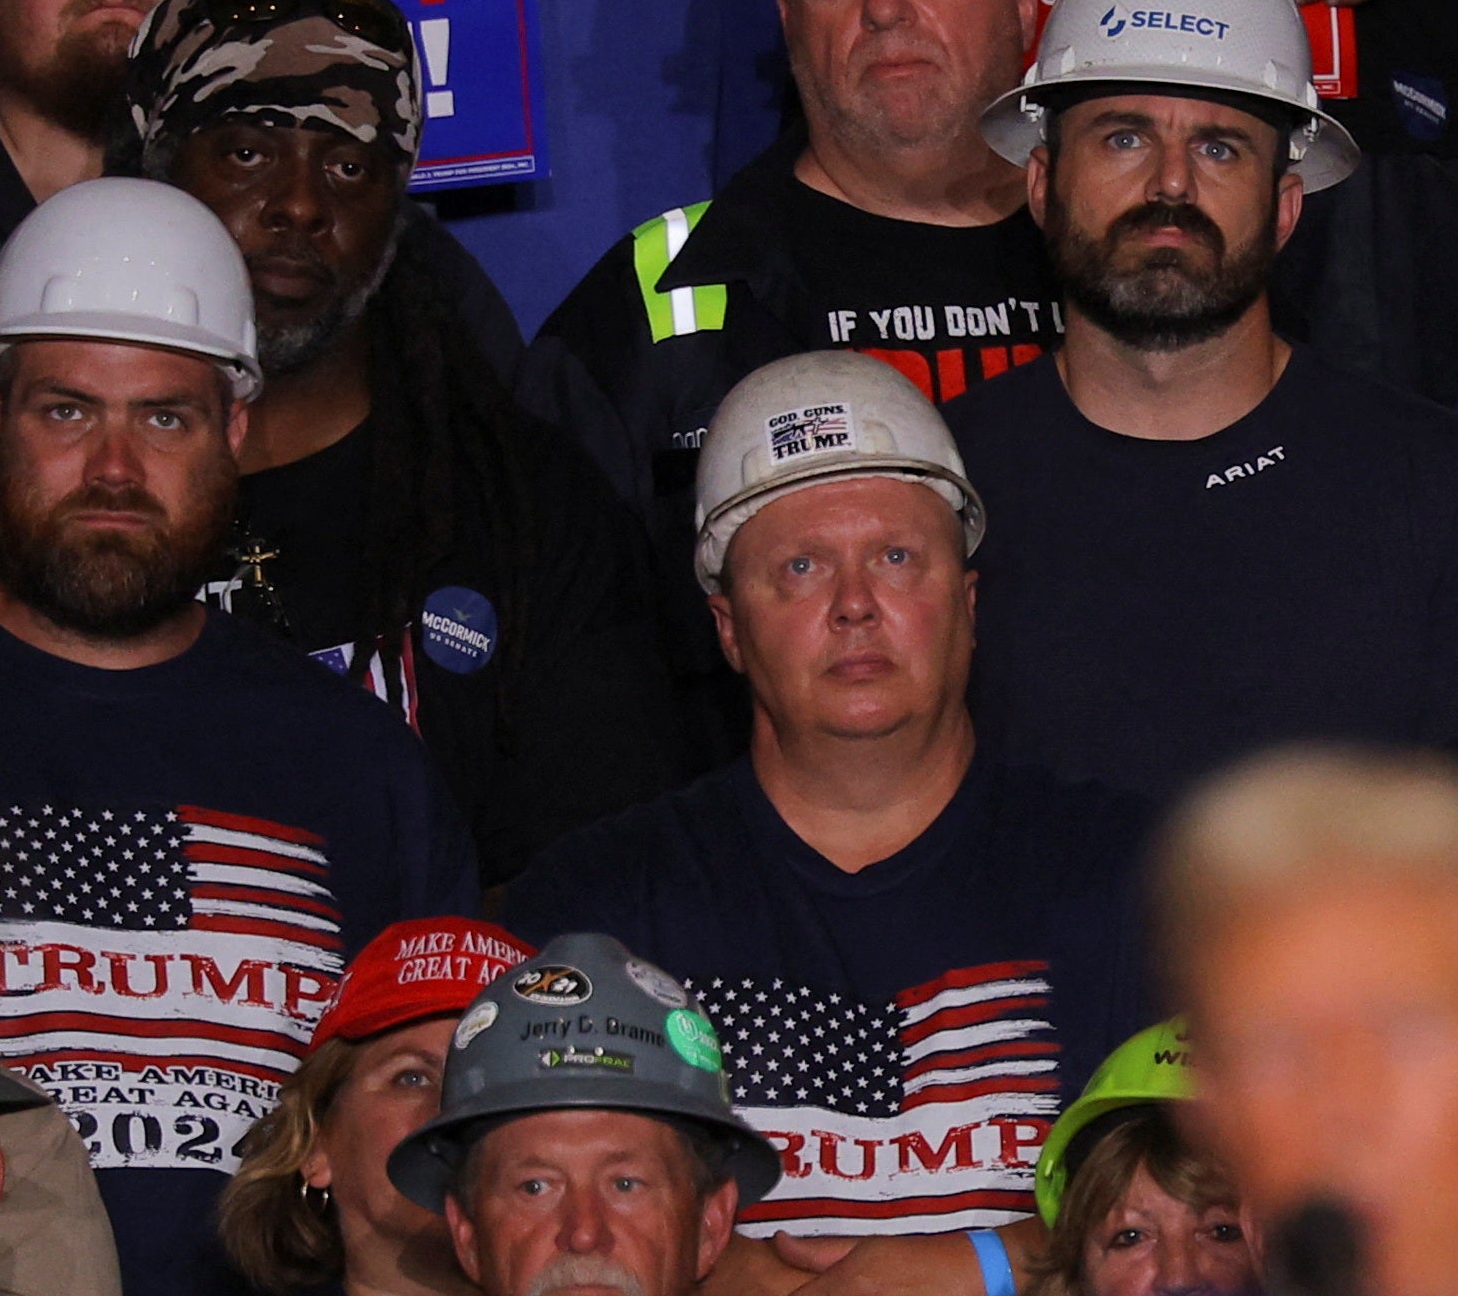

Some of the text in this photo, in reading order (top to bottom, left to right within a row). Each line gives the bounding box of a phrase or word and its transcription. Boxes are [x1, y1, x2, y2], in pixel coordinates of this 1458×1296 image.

[1131, 10, 1230, 40] SELECT
[828, 310, 858, 343] IF
[869, 305, 936, 341] YOU
[944, 297, 1041, 337] DON'T
[1205, 445, 1286, 490] ARIAT
[444, 638, 478, 658] SENATE
[394, 932, 453, 961] MAKE
[397, 957, 471, 985] GREAT
[519, 1016, 572, 1042] Jerry
[563, 1053, 630, 1069] PROFRAC
[775, 1117, 1057, 1181] RUMP
